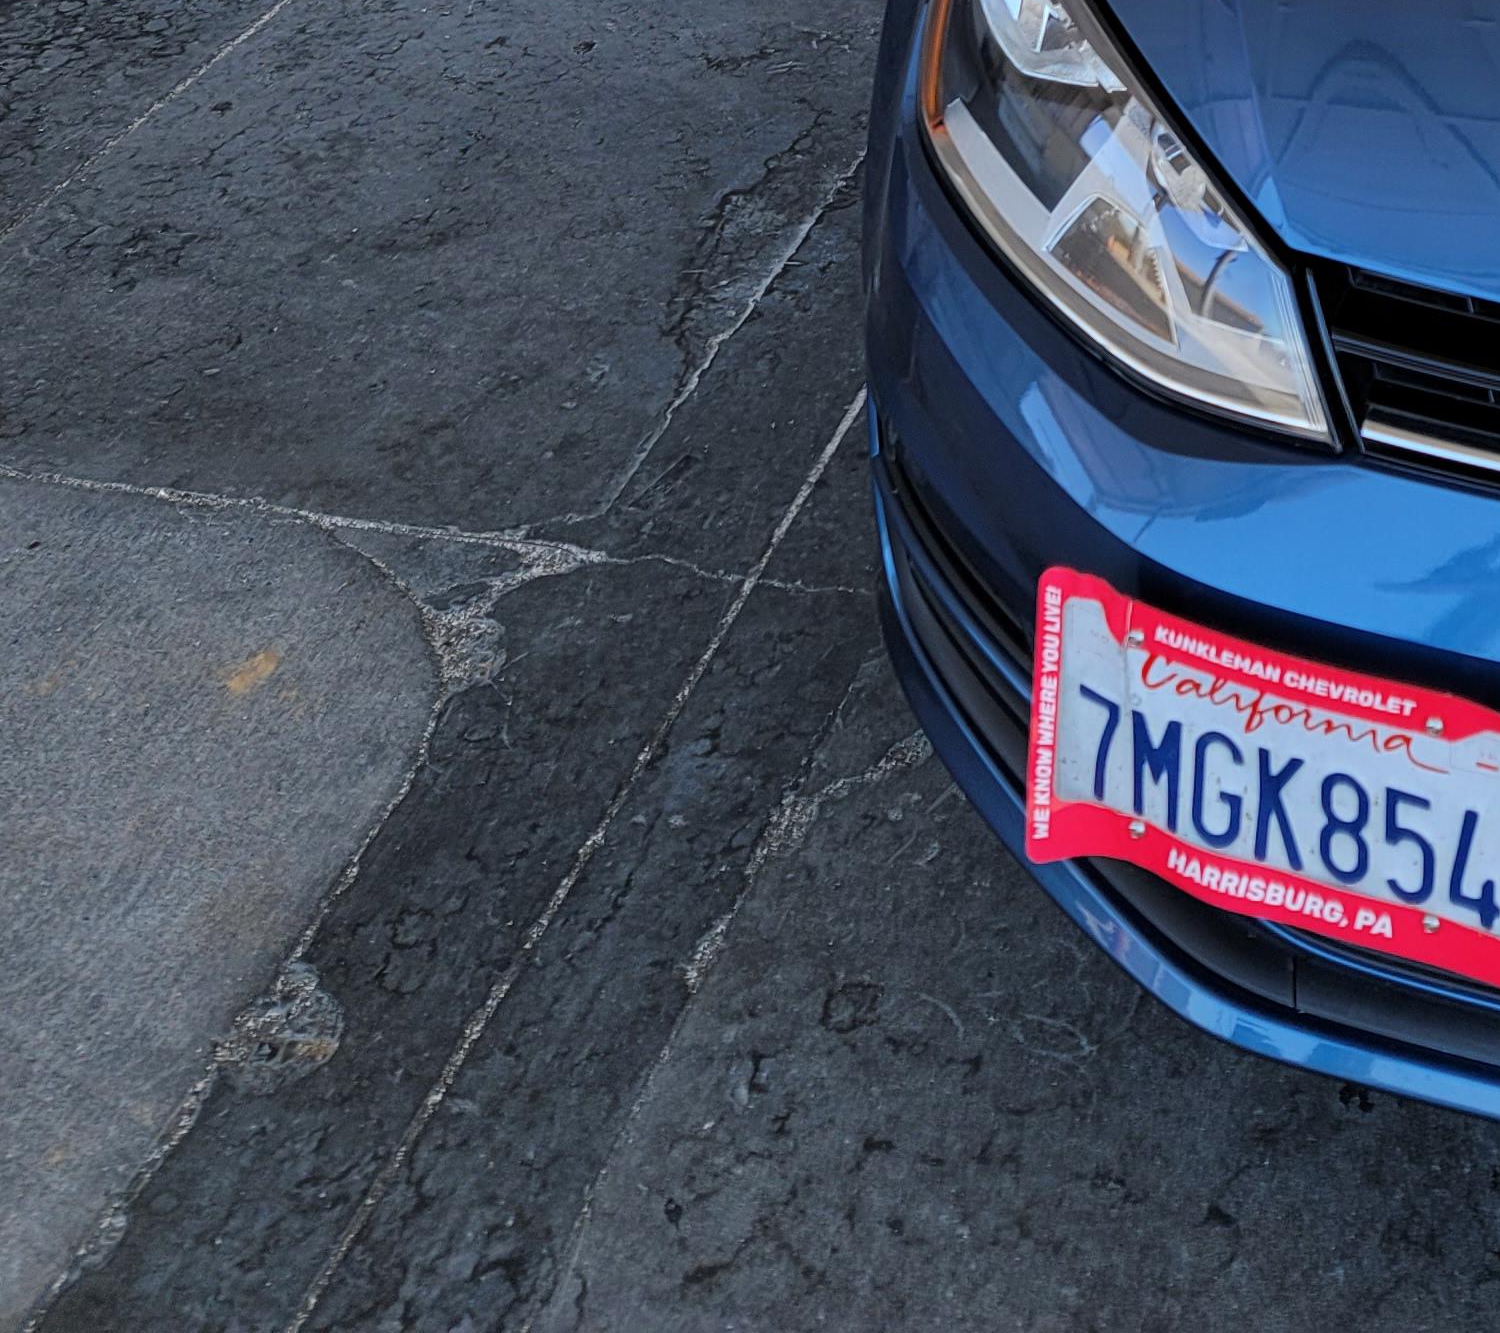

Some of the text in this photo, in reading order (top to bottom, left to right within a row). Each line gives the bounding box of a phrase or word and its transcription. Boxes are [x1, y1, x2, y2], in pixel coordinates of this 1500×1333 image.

[1032, 585, 1062, 840] WE KNOW WHERE YOU LIVE!
[1141, 652, 1449, 774] California
[1154, 625, 1417, 717] KUNKLEMAN CHEVROLET
[1080, 683, 1500, 931] 7MGK854
[1167, 848, 1393, 939] HARRISBURG, PA
